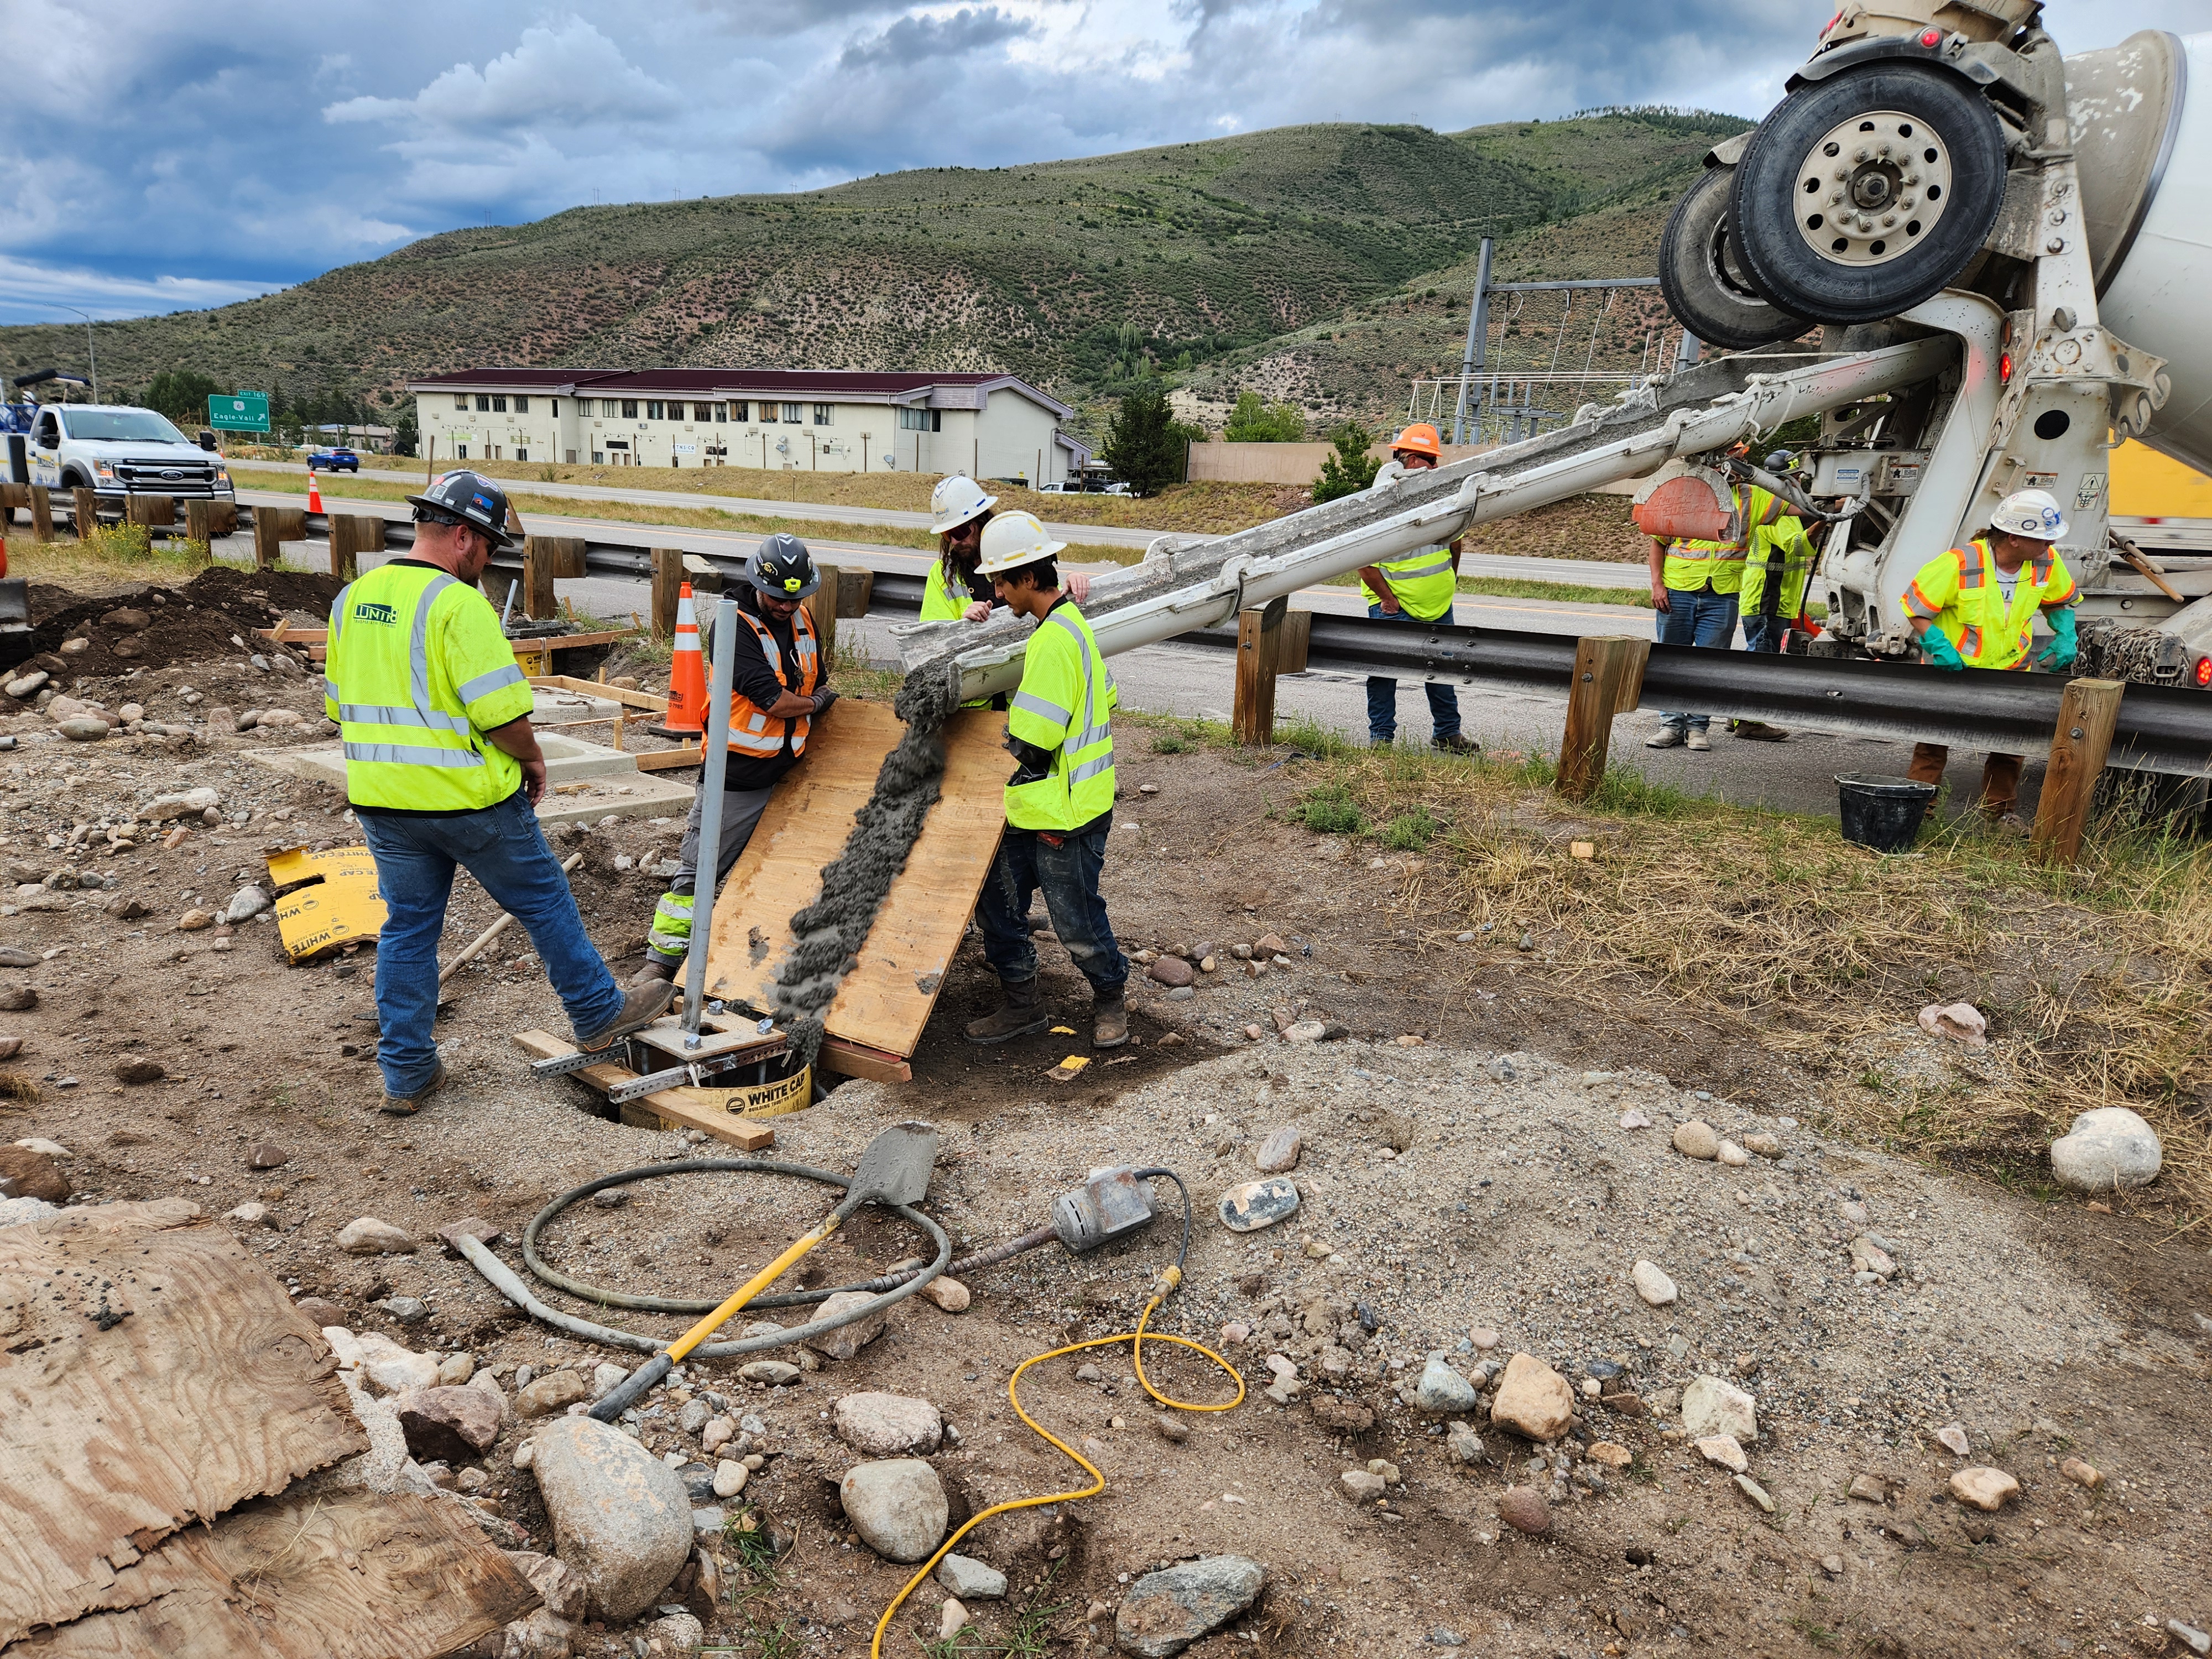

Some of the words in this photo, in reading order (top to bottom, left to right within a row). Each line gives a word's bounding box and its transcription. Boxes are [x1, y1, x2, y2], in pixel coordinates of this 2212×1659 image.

[213, 413, 254, 421] Eagle-Vail
[291, 932, 331, 956] WHITE
[748, 1083, 788, 1106] WHITE
[789, 1072, 805, 1092] CAP
[748, 1103, 770, 1113] BUILDING
[771, 1098, 784, 1107] TRUST
